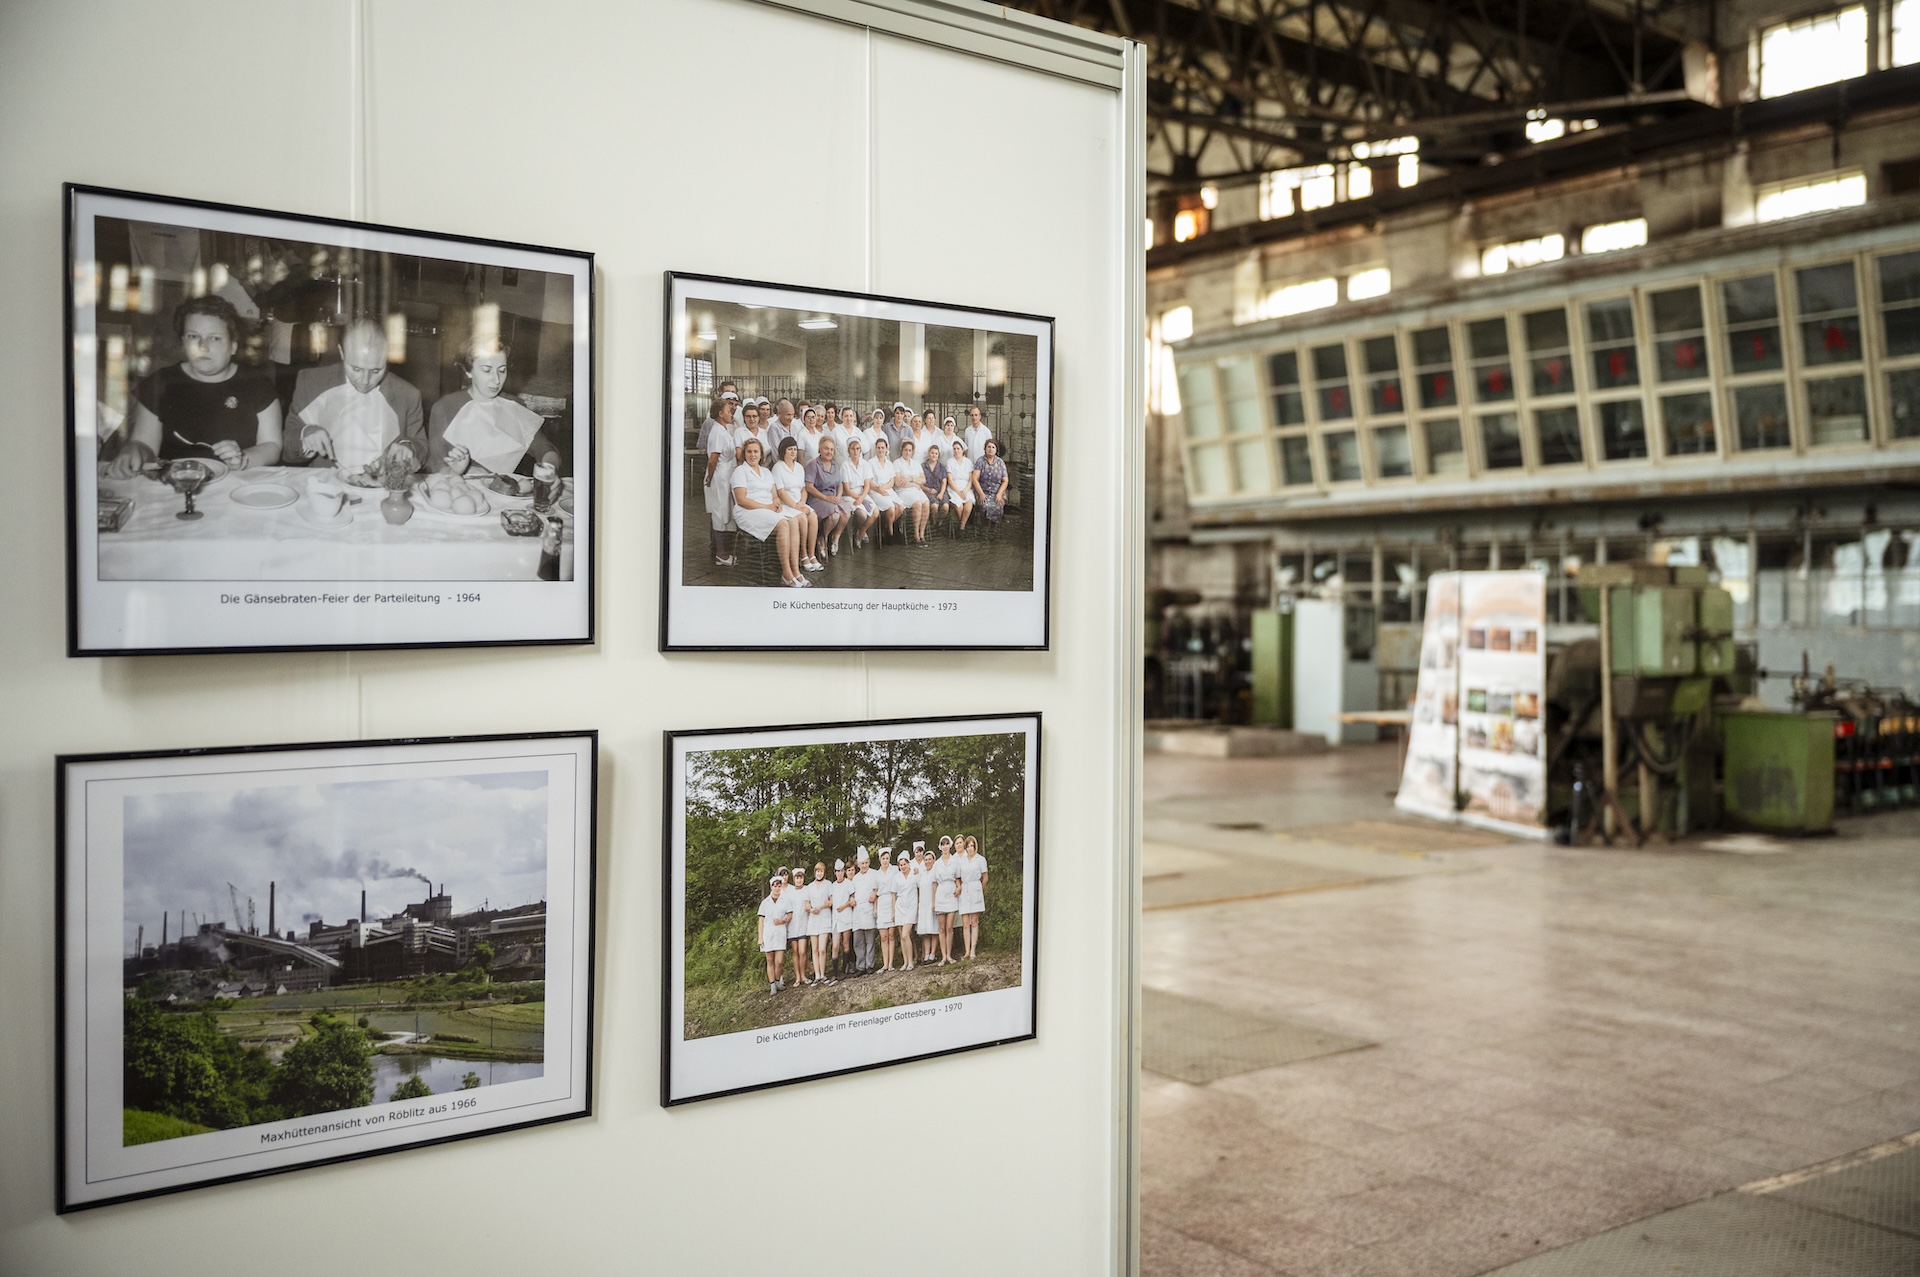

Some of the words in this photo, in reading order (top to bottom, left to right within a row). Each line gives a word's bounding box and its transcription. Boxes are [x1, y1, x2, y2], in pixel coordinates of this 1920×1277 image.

[220, 593, 240, 604] Die
[244, 593, 350, 605] Gänsebraten-Feier
[353, 593, 372, 604] der
[375, 593, 441, 605] Parteileitung
[456, 592, 481, 603] 1964
[772, 600, 787, 610] Die
[790, 601, 864, 612] Küchenbesatzung
[866, 601, 880, 611] der
[882, 602, 929, 612] Hauptküche
[938, 602, 958, 611] 1973
[755, 1033, 771, 1045] Die
[773, 1024, 834, 1042] Küchenbrigade
[836, 1021, 847, 1031] im
[849, 1015, 893, 1029] Ferienlager
[894, 1008, 936, 1022] Gottesberg
[944, 1002, 963, 1013] 1970
[260, 1117, 362, 1145] Maxhüttenansicht
[365, 1114, 385, 1127] von
[389, 1106, 426, 1122] Röblitz
[428, 1104, 447, 1116] aus
[451, 1097, 478, 1111] 1966
